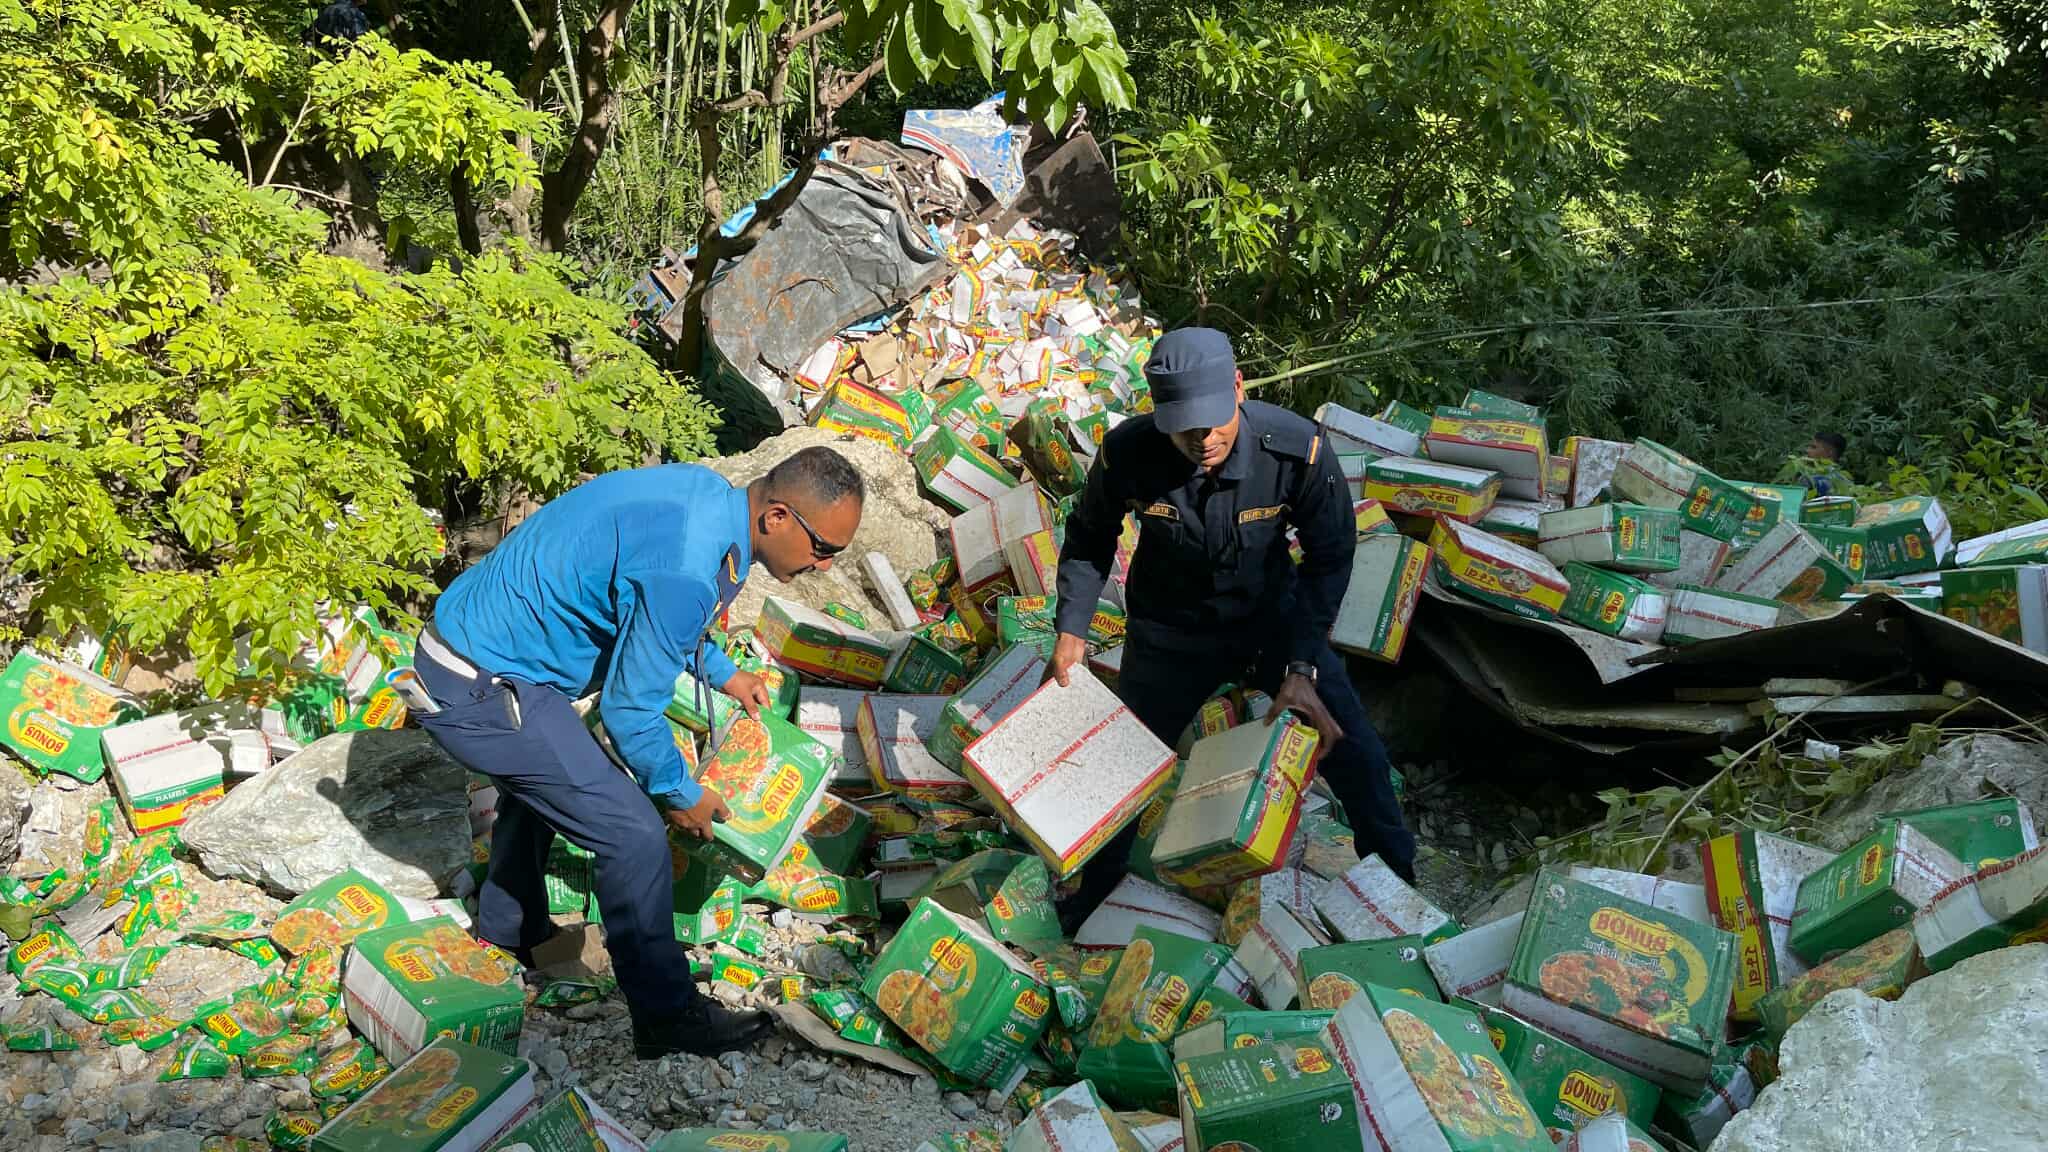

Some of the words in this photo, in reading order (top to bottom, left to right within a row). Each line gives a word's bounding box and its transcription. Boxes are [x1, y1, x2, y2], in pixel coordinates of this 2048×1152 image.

[1093, 614, 1125, 633] BONUS
[366, 697, 391, 725] BONUS
[24, 725, 65, 753] BONUS
[155, 788, 189, 803] RAMBA
[764, 769, 800, 815] BONUS
[343, 886, 376, 914] BONUS
[802, 890, 838, 908] BONUS
[1596, 913, 1668, 952] BONUS
[19, 936, 50, 960] BONUS
[399, 953, 430, 981] BONUS
[1017, 991, 1046, 1014] BONUS
[1151, 980, 1187, 1027] BONUS
[212, 1014, 241, 1037] BONUS
[1564, 1076, 1610, 1112] BONUS
[429, 1089, 475, 1129] BONUS
[717, 1133, 767, 1149] BONUS
